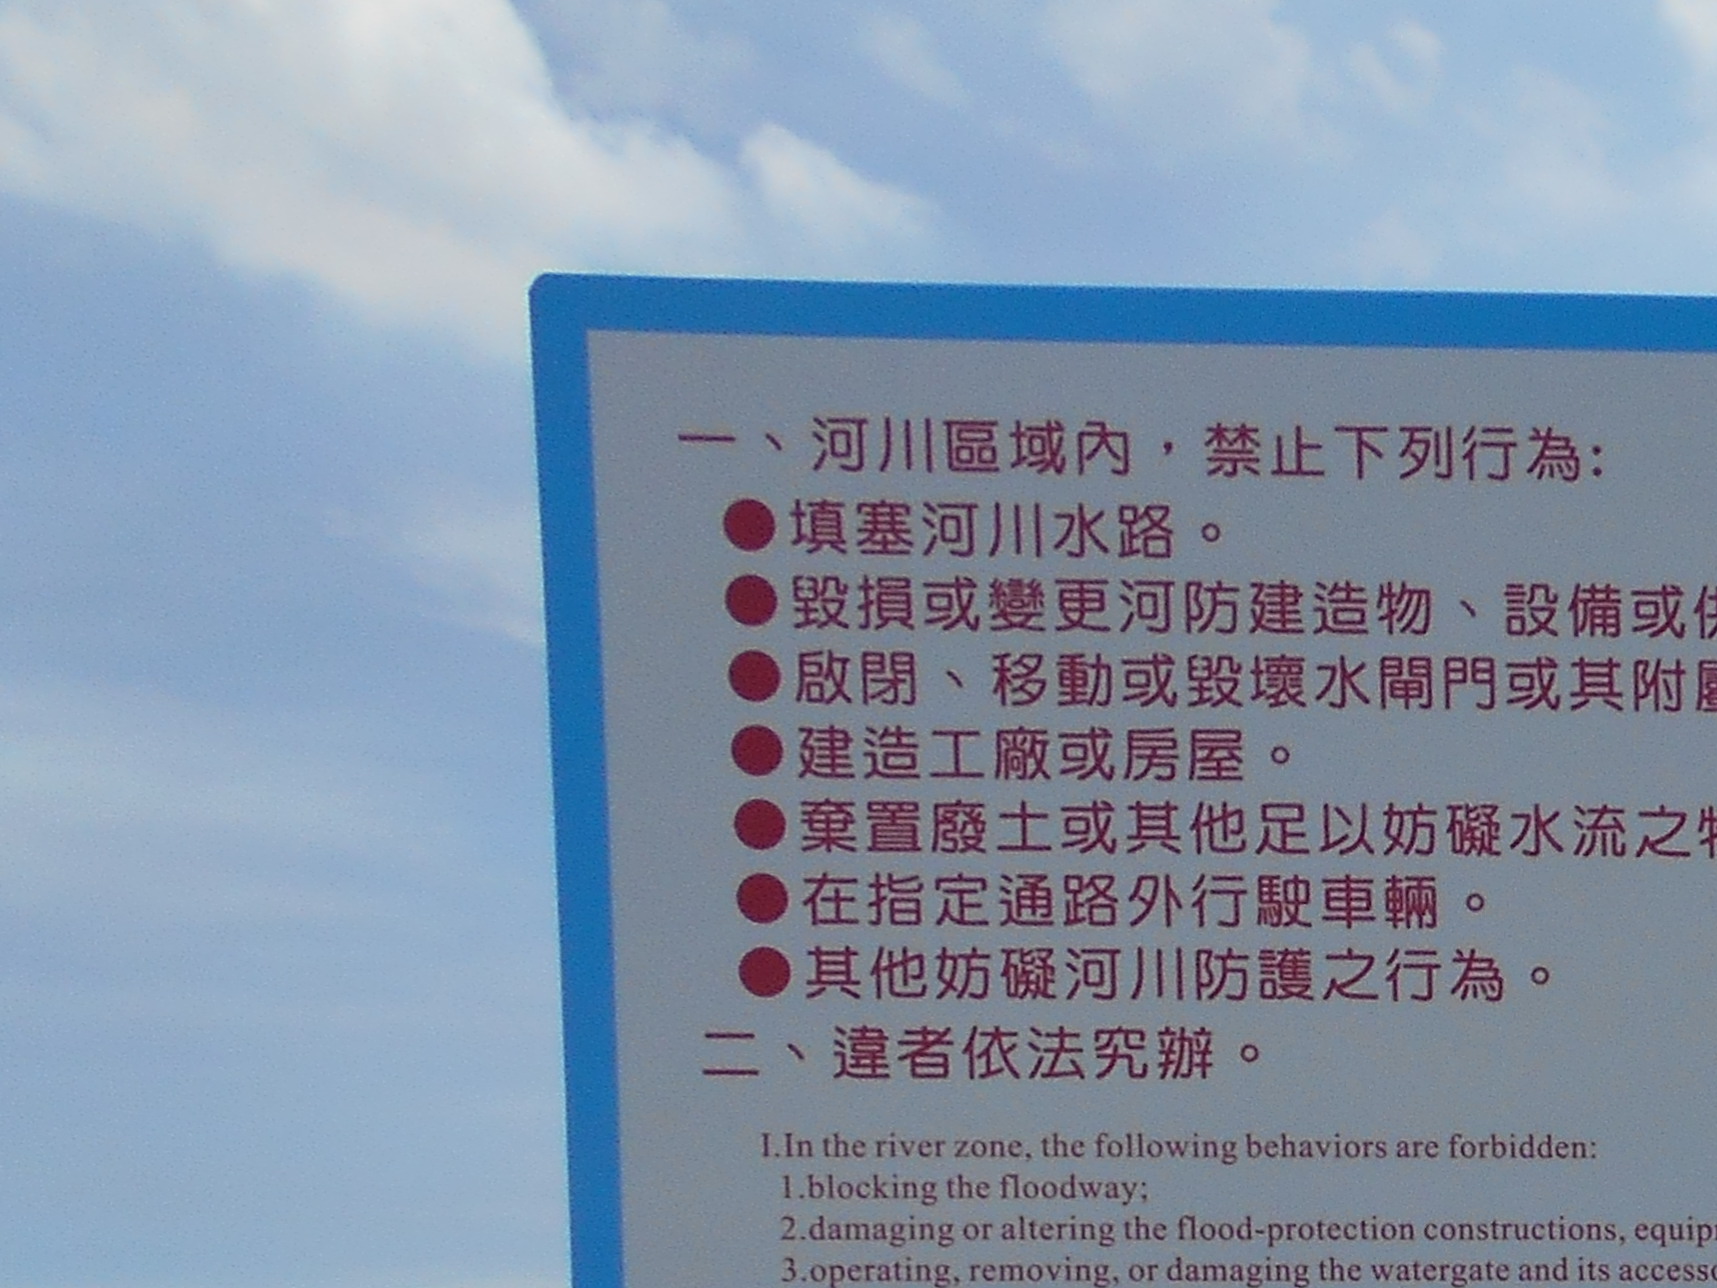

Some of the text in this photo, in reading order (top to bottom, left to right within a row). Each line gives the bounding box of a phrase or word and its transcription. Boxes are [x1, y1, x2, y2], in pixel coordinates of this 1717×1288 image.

[789, 499, 1222, 559] 填塞河川水路。
[796, 724, 1293, 784] 建造工廠或房屋。
[802, 871, 1488, 931] 在指定通路外行駛車輛。
[805, 945, 1554, 1004] 其他妨礙河川防護之行為。
[701, 1025, 1263, 1082] 二、違者依法究辦。
[761, 1131, 1597, 1165] I.In the river zone, the following behaviors are forbidden:
[782, 1172, 1148, 1206] 1.blocking the floodway;
[779, 1214, 956, 1249] 2.damaging
[962, 1222, 994, 1242] or
[999, 1214, 1116, 1248] altering
[1122, 1215, 1168, 1242] the
[1177, 1214, 1415, 1249] flood-protection
[1423, 1215, 1627, 1247] constructions,
[780, 1256, 961, 1288] 3.operating,
[968, 1255, 1120, 1288] removing,
[1127, 1263, 1160, 1283] or
[1318, 1256, 1362, 1283] the
[1370, 1259, 1511, 1288] watergate
[1517, 1256, 1569, 1283] and
[1577, 1256, 1611, 1283] its
